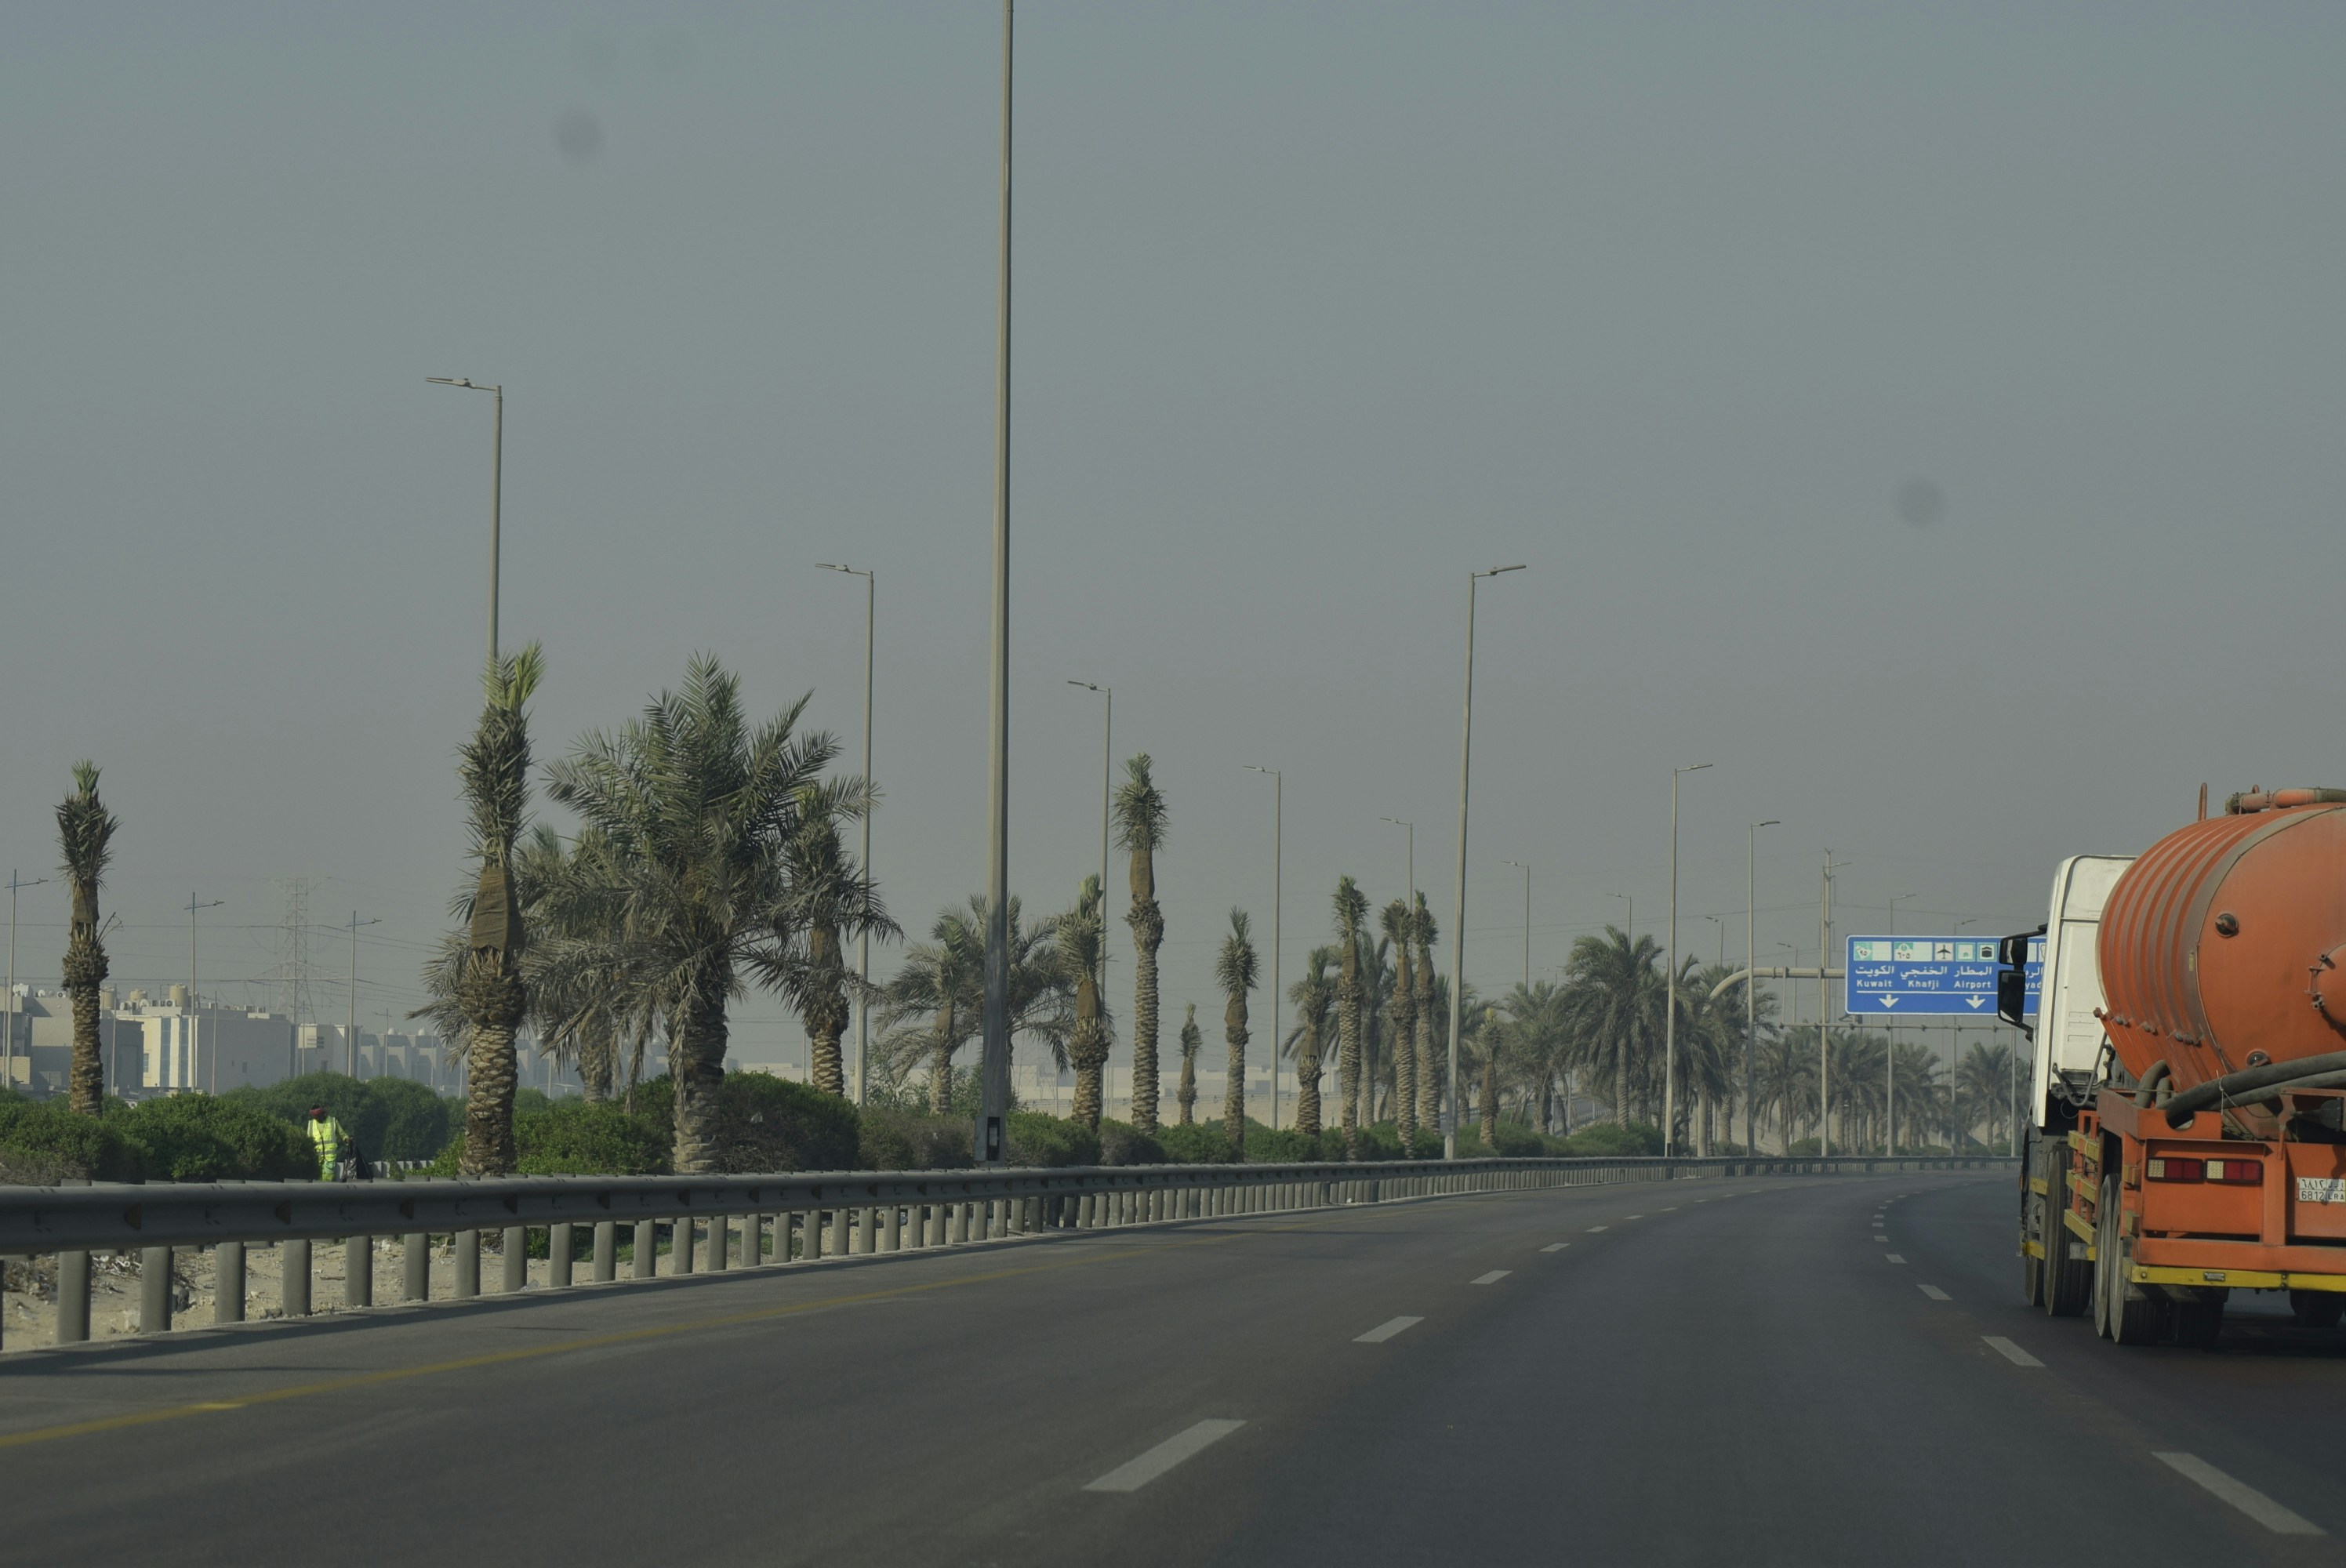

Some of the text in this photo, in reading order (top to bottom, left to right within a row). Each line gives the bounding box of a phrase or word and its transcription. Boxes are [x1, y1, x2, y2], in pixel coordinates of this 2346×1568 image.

[1855, 965, 1894, 977] الكويت
[1900, 966, 1947, 980] الخفجي
[1954, 966, 1992, 977] المطار
[1908, 980, 1939, 989] Khafji
[2301, 1191, 2324, 1201] 6812
